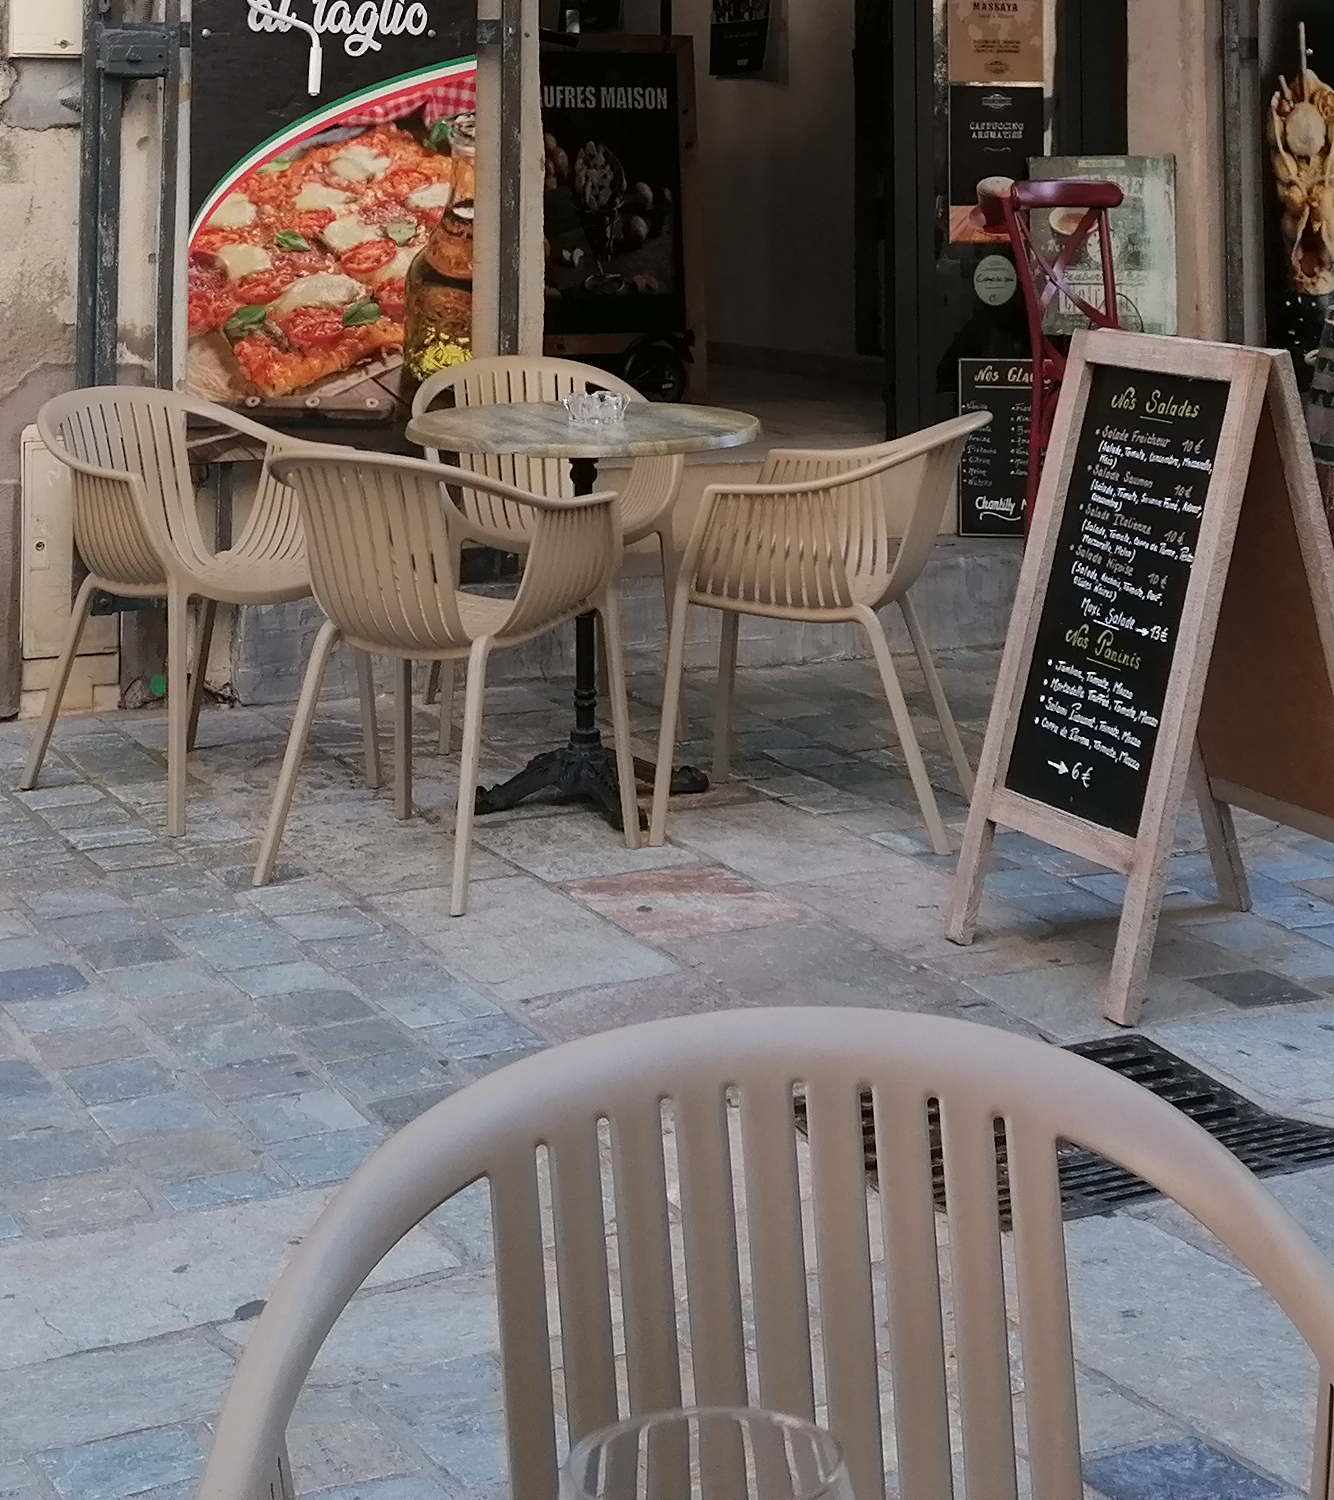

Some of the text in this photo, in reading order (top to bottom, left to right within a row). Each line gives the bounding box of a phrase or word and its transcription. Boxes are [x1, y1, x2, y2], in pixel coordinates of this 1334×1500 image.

[540, 84, 668, 110] UFRES MAISON
[974, 364, 999, 383] Nos
[1111, 387, 1200, 419] Nos Salades
[1065, 623, 1142, 670] Nos Paninis
